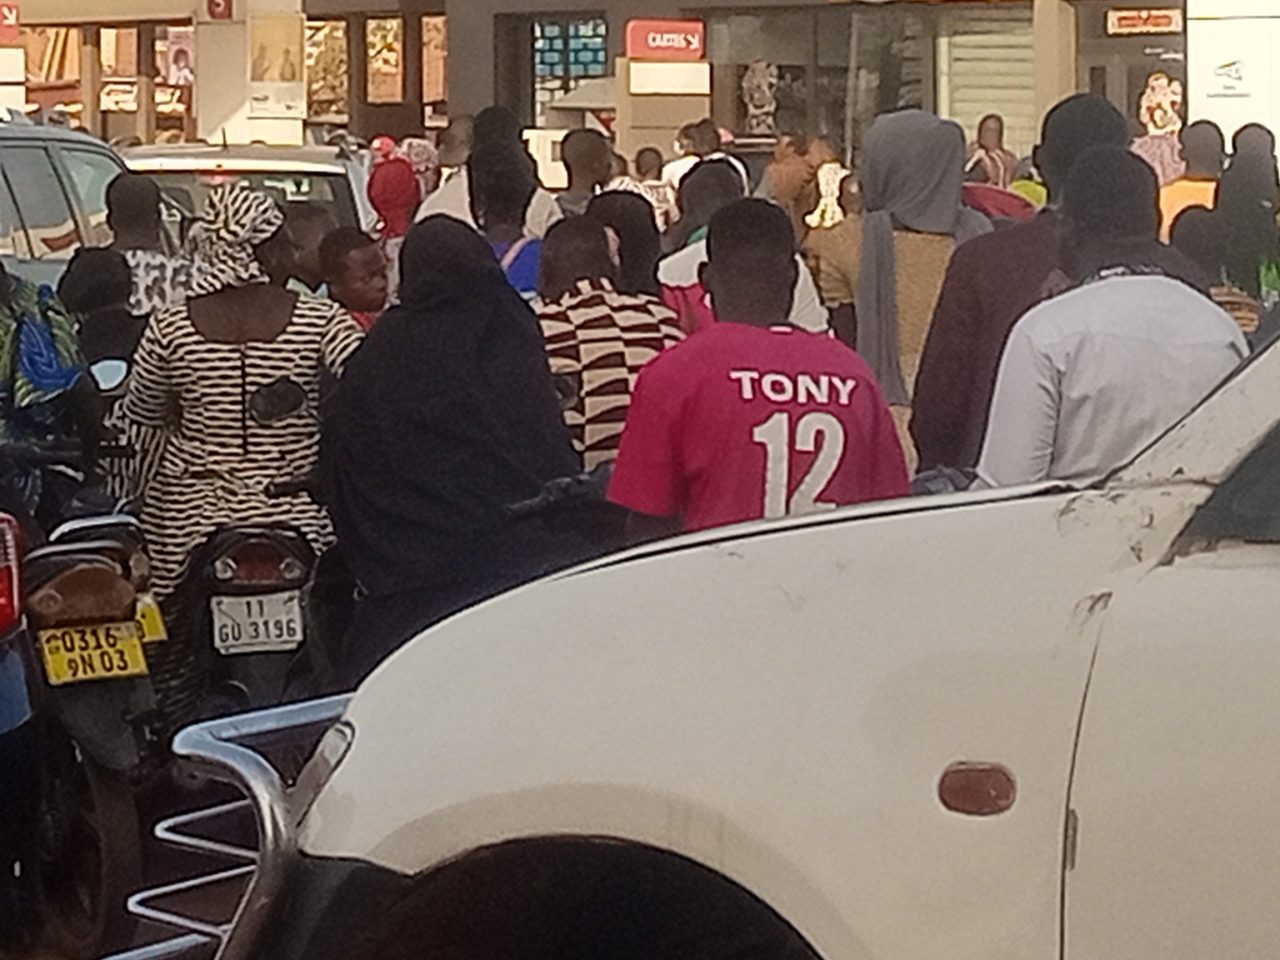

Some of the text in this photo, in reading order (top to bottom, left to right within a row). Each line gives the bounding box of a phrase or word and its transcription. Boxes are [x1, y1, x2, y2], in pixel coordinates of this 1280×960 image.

[729, 370, 856, 405] TONY
[752, 411, 845, 519] 12
[61, 626, 118, 653] 0316
[249, 618, 297, 639] 3196
[68, 648, 128, 678] 9N 03
